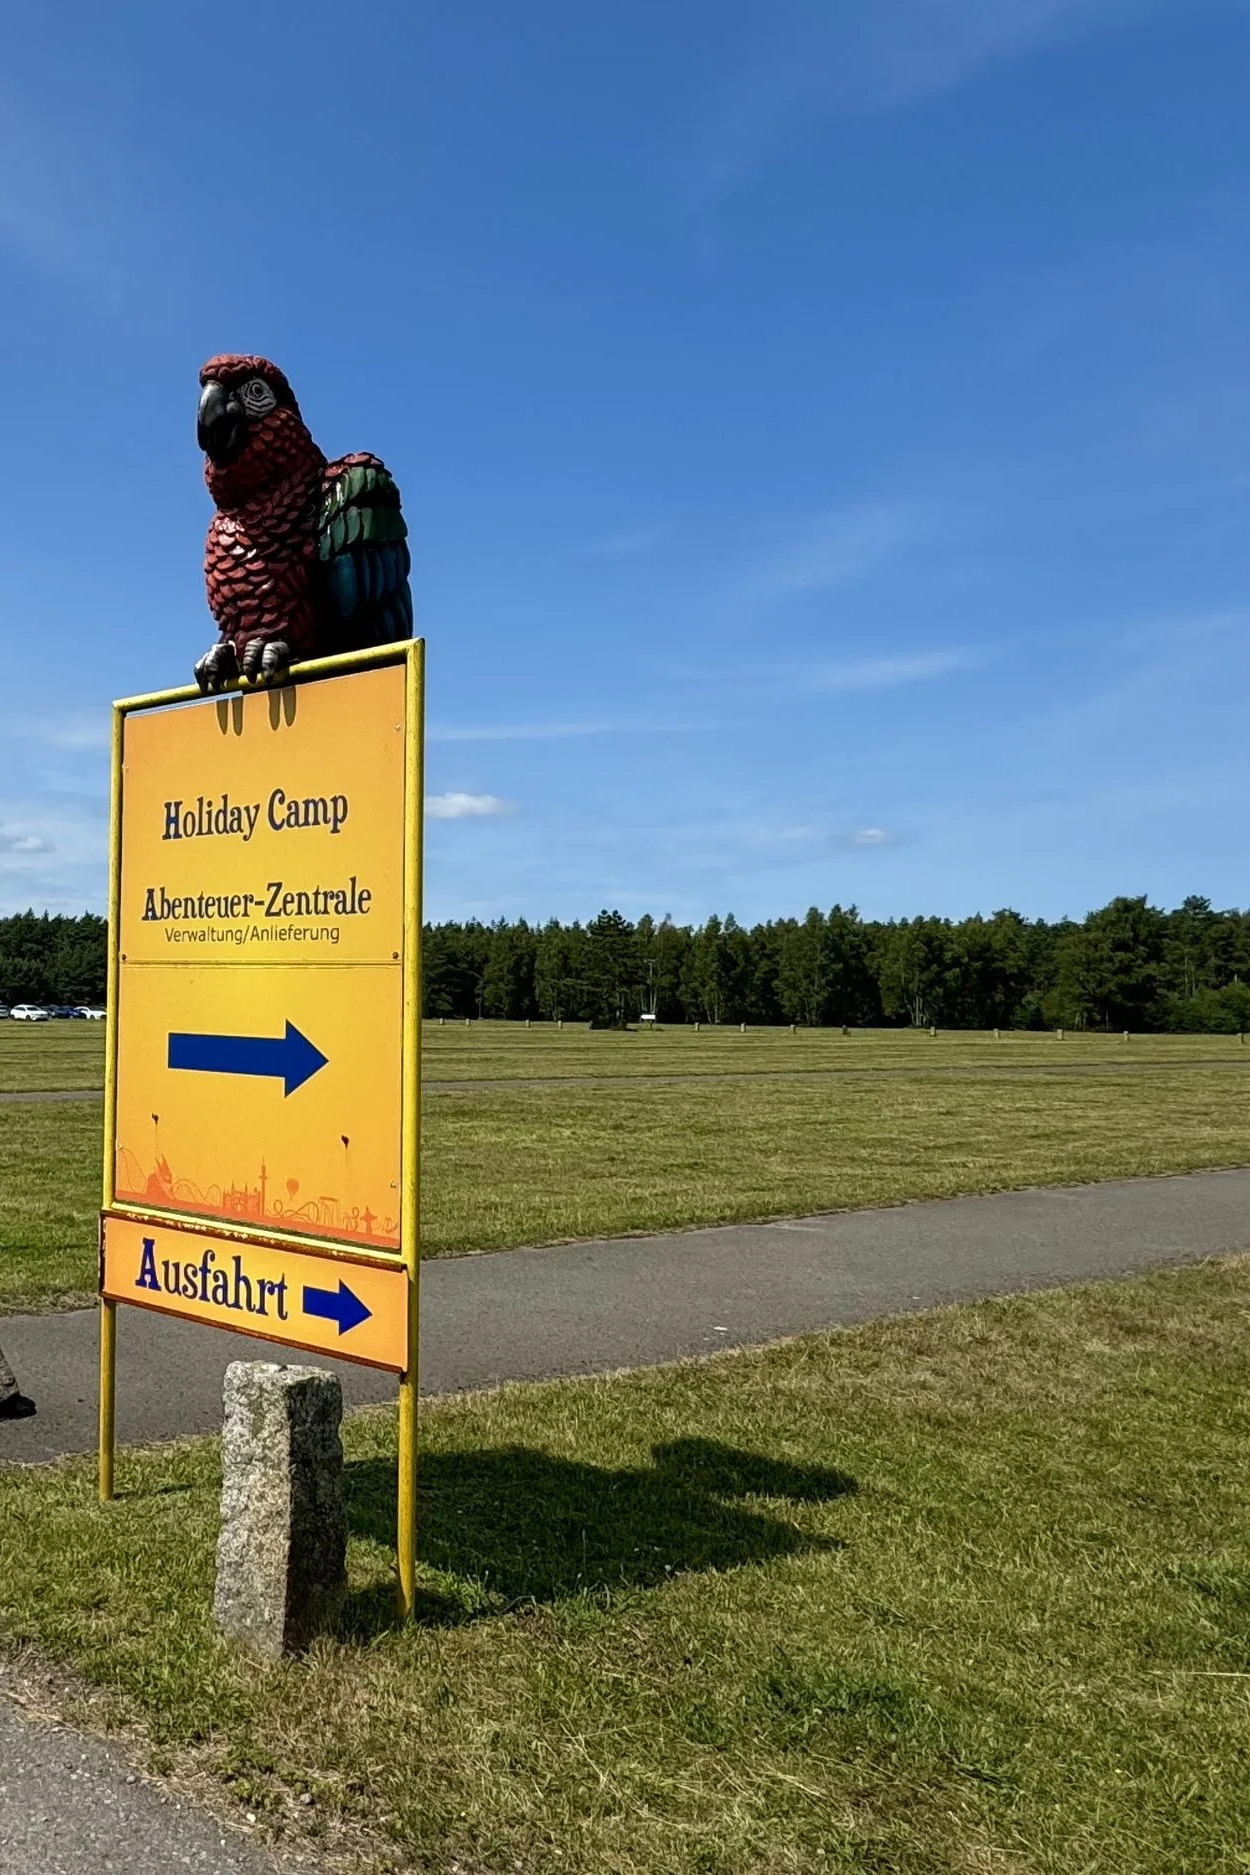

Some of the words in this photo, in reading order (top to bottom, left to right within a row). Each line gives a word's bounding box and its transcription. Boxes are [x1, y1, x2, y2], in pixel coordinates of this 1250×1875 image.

[162, 794, 260, 841] Holiday
[268, 788, 348, 834] Camp
[141, 875, 372, 921] Abenteuer-Zentrale
[165, 924, 340, 944] Verwaltung/Anlieferung
[135, 1237, 288, 1320] Ausfahrt
